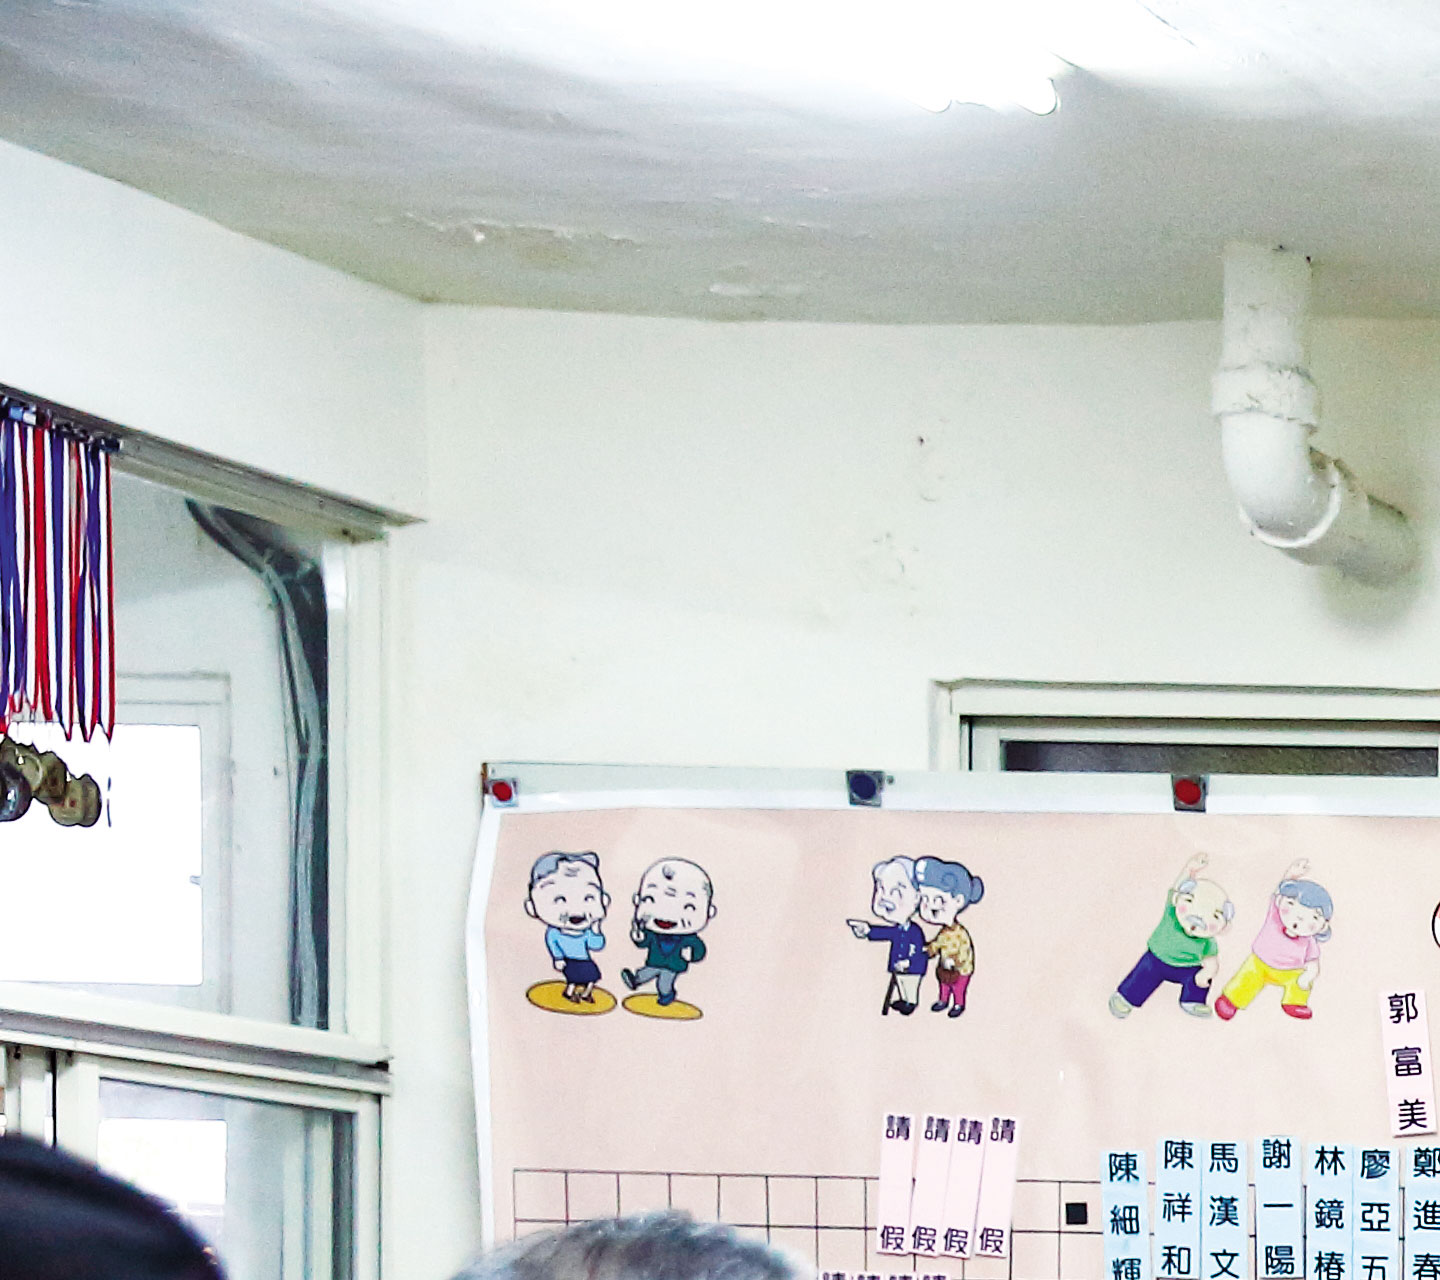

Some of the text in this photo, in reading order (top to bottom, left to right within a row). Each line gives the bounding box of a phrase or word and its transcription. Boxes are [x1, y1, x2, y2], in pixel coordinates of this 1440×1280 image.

[1388, 993, 1427, 1130] 郭富美
[1161, 1140, 1194, 1275] 陳祥和
[1209, 1143, 1239, 1279] 馬漢文
[1262, 1139, 1295, 1275] 謝一陽
[1314, 1145, 1345, 1280] 林鏡椿
